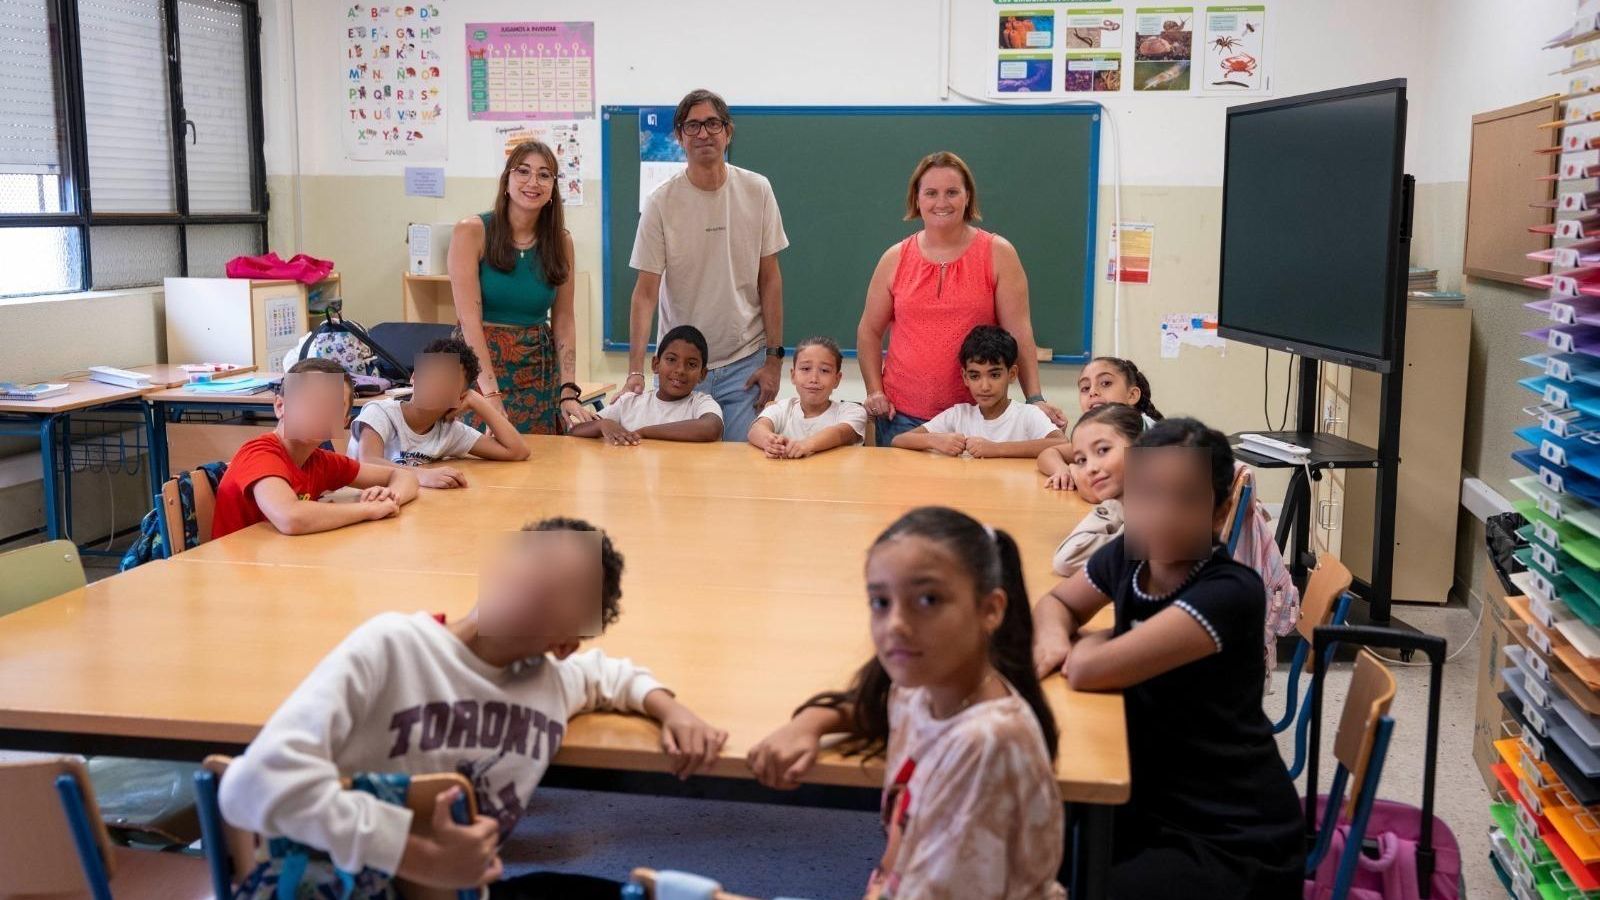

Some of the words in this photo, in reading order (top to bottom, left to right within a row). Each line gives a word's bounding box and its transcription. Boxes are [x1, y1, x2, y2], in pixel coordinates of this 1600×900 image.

[371, 7, 378, 18] B
[420, 8, 428, 18] D
[396, 28, 404, 38] G
[396, 49, 404, 59] K
[421, 49, 426, 59] L
[349, 69, 359, 79] M
[349, 88, 357, 99] P
[373, 89, 382, 100] Q
[397, 90, 404, 100] R
[421, 90, 428, 100] S
[350, 110, 356, 119] T
[374, 110, 382, 120] U
[397, 111, 405, 120] V
[358, 129, 366, 140] X
[383, 130, 389, 140] Y
[406, 131, 413, 141] Z
[389, 700, 563, 760] TORONTO
